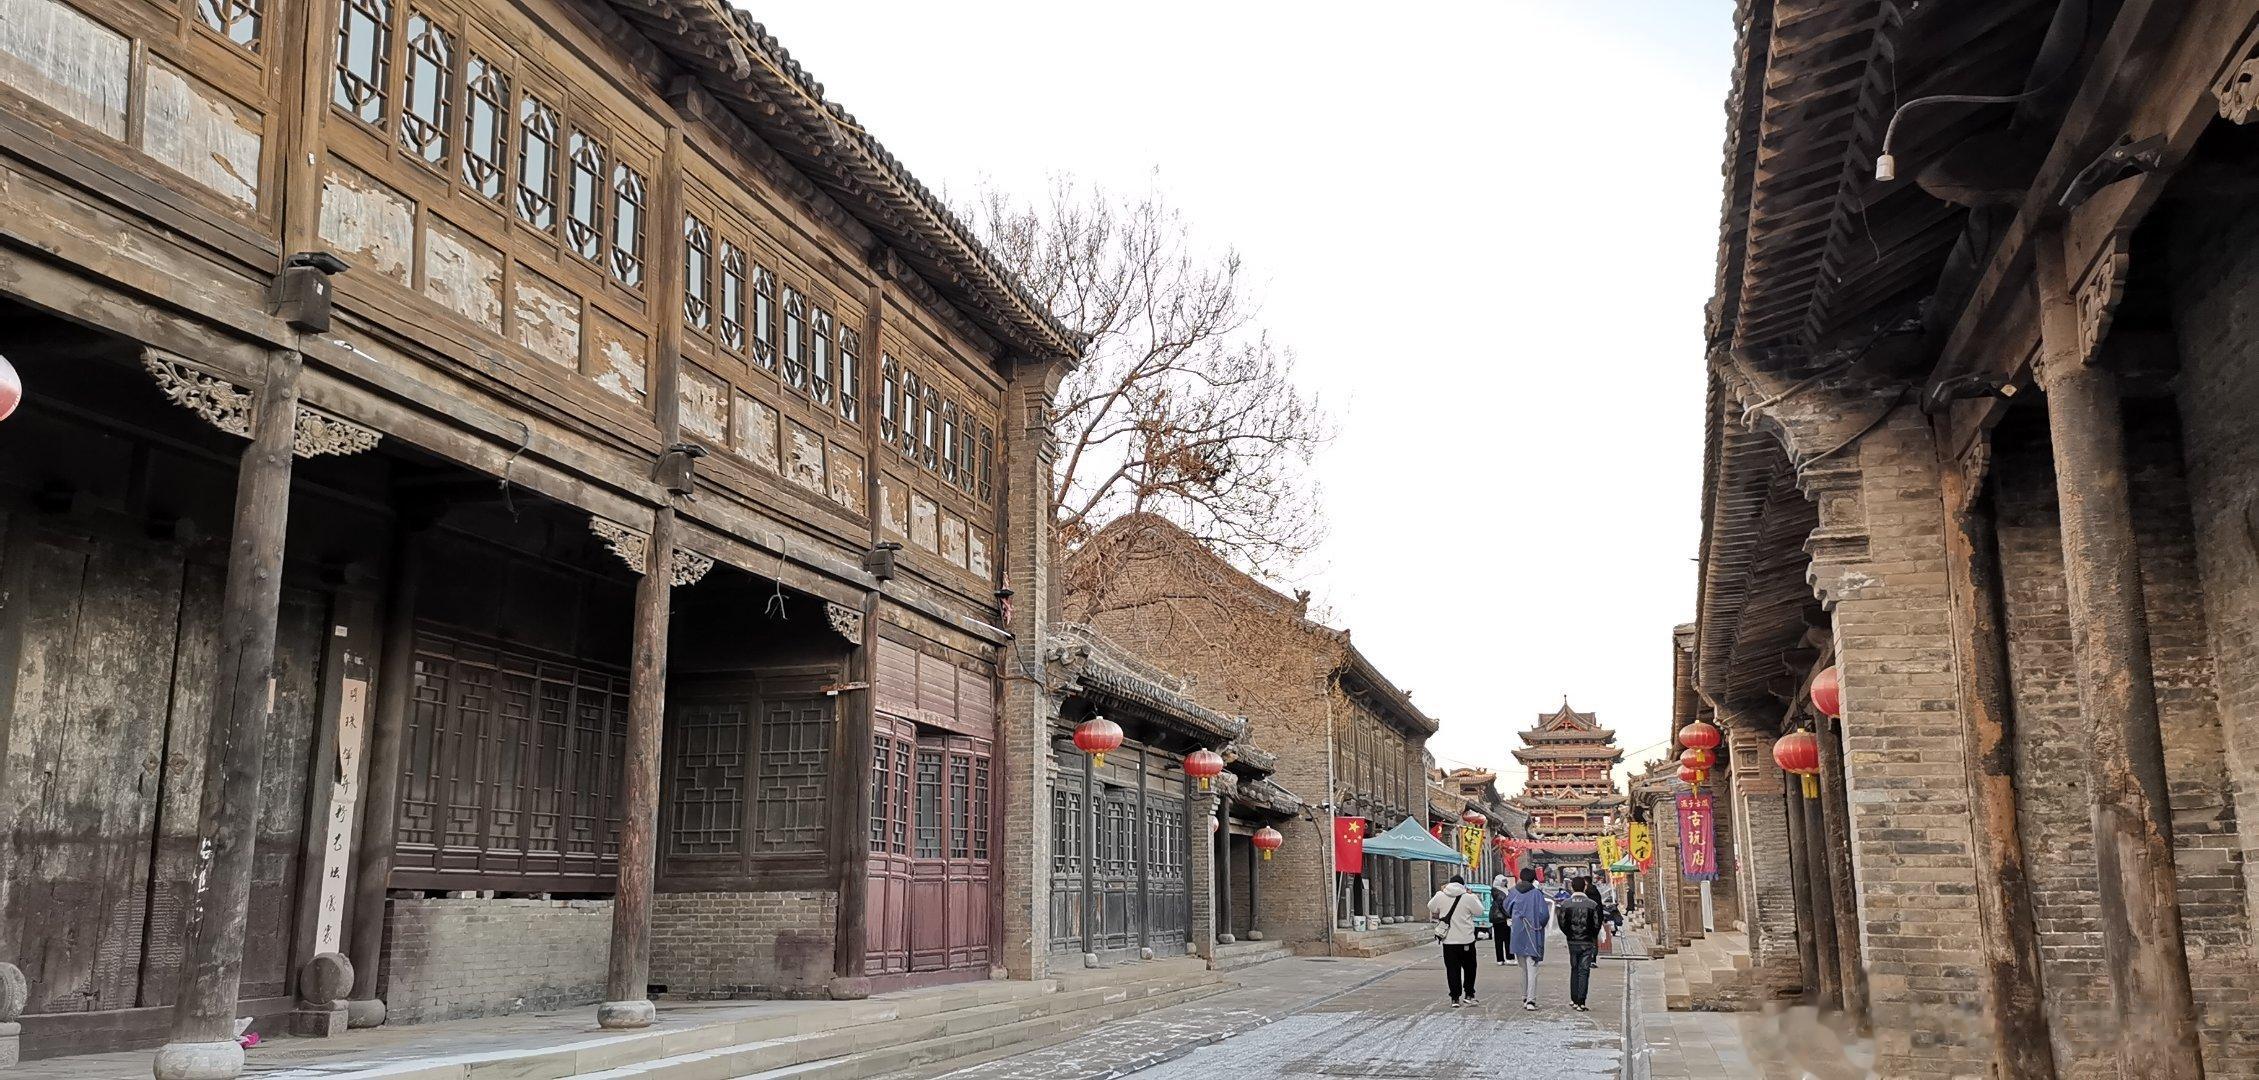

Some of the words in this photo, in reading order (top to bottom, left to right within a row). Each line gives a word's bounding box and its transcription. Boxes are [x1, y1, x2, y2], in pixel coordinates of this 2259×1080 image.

[1388, 833, 1425, 841] vivo
[1687, 811, 1706, 867] 古玩店
